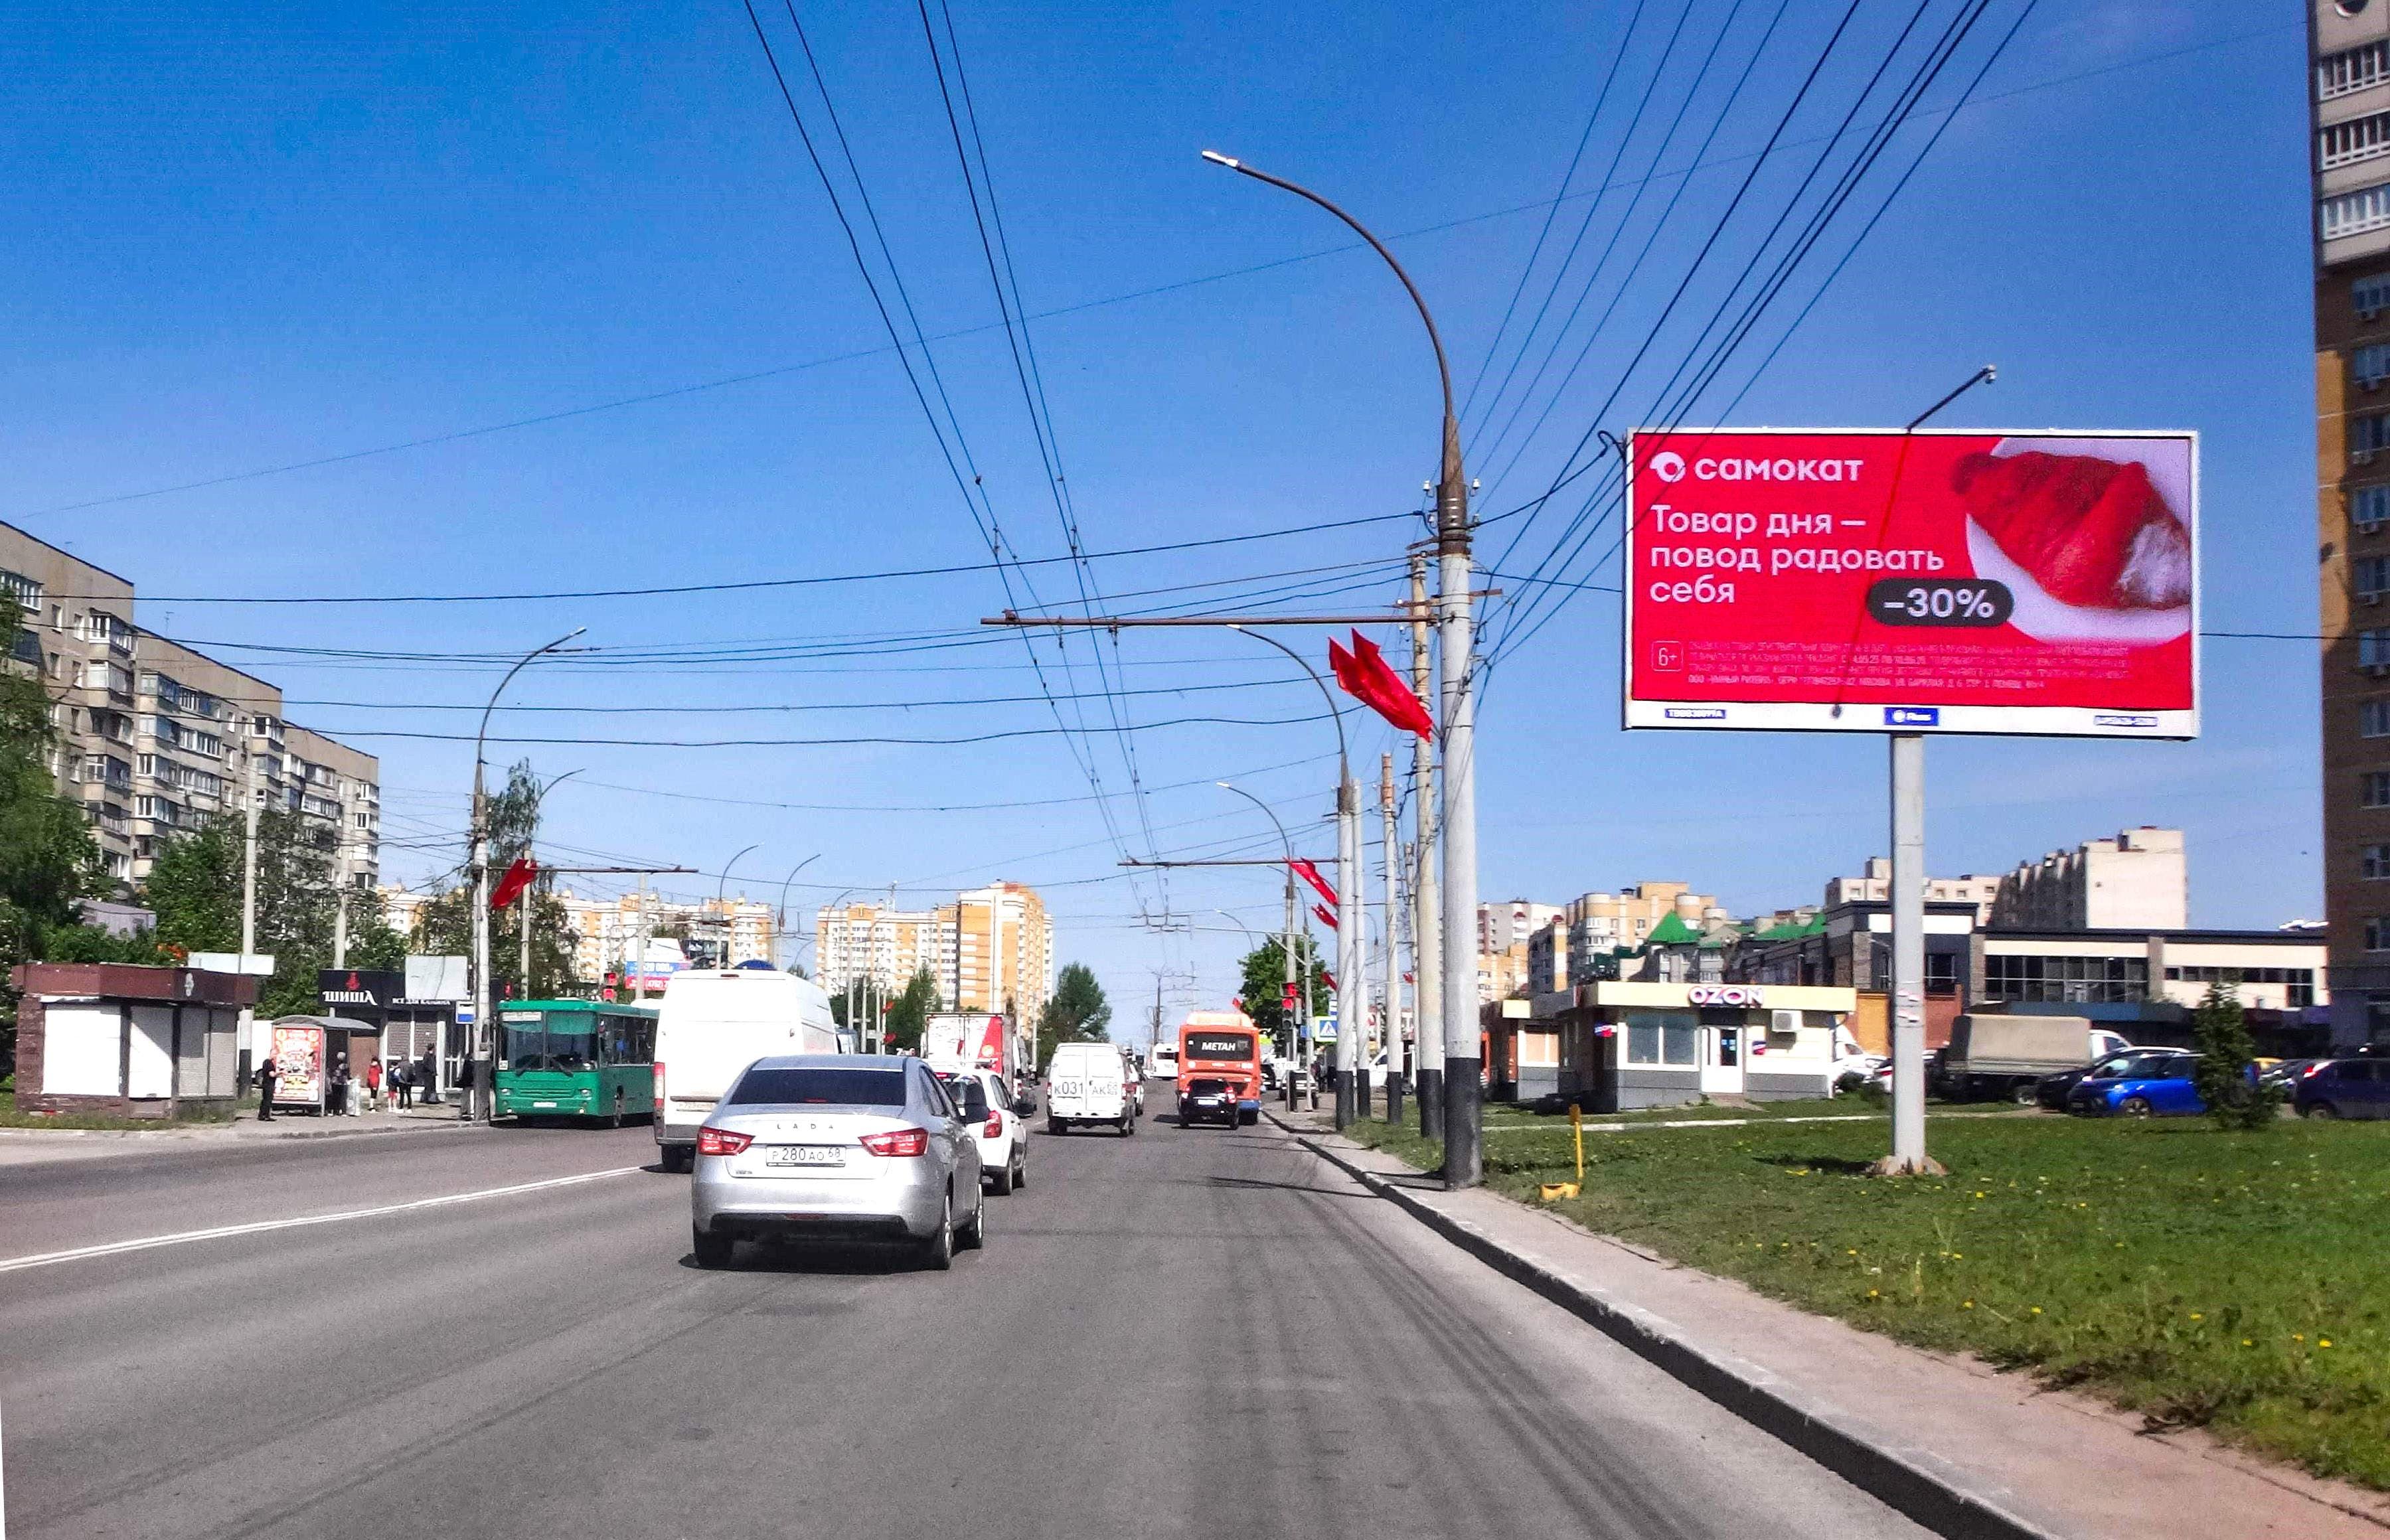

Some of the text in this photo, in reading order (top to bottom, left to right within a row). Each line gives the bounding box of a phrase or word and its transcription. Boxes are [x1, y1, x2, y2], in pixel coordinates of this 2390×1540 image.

[1694, 458, 1864, 481] самокат
[1650, 504, 1757, 540] Товар
[1766, 513, 1832, 538] дня
[1650, 547, 1944, 575] повод радовать
[1650, 574, 1735, 603] себя
[1658, 647, 1678, 666] 6+
[323, 990, 378, 1006] ШИША
[1689, 986, 1763, 1005] OZON
[1202, 1041, 1235, 1051] МЕТАН
